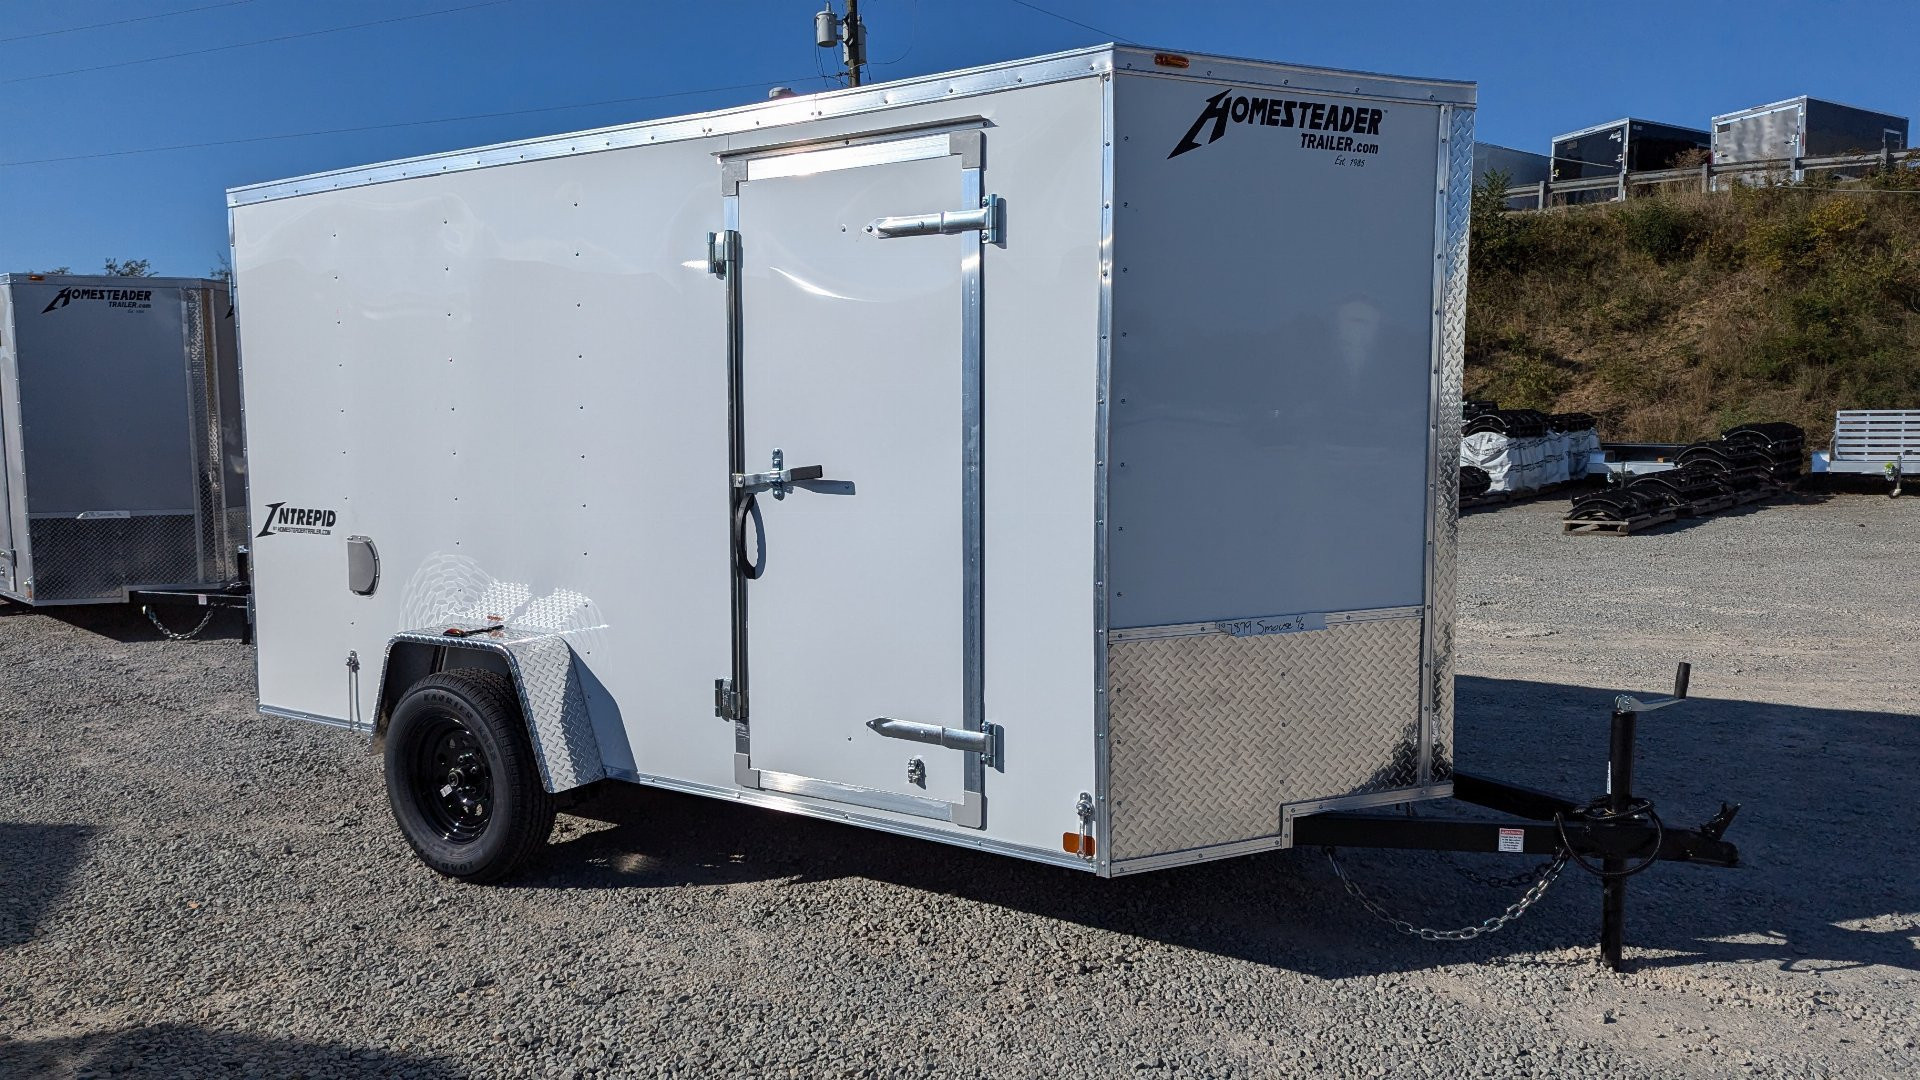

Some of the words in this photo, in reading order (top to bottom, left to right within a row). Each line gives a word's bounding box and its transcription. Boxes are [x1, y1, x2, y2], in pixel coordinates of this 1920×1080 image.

[1167, 88, 1383, 160] HOMESTEADER
[1301, 132, 1379, 155] TRAILER.com
[41, 286, 152, 314] HOMESTEADER
[108, 300, 152, 310] TRAILER.com
[255, 501, 337, 538] INTREPID
